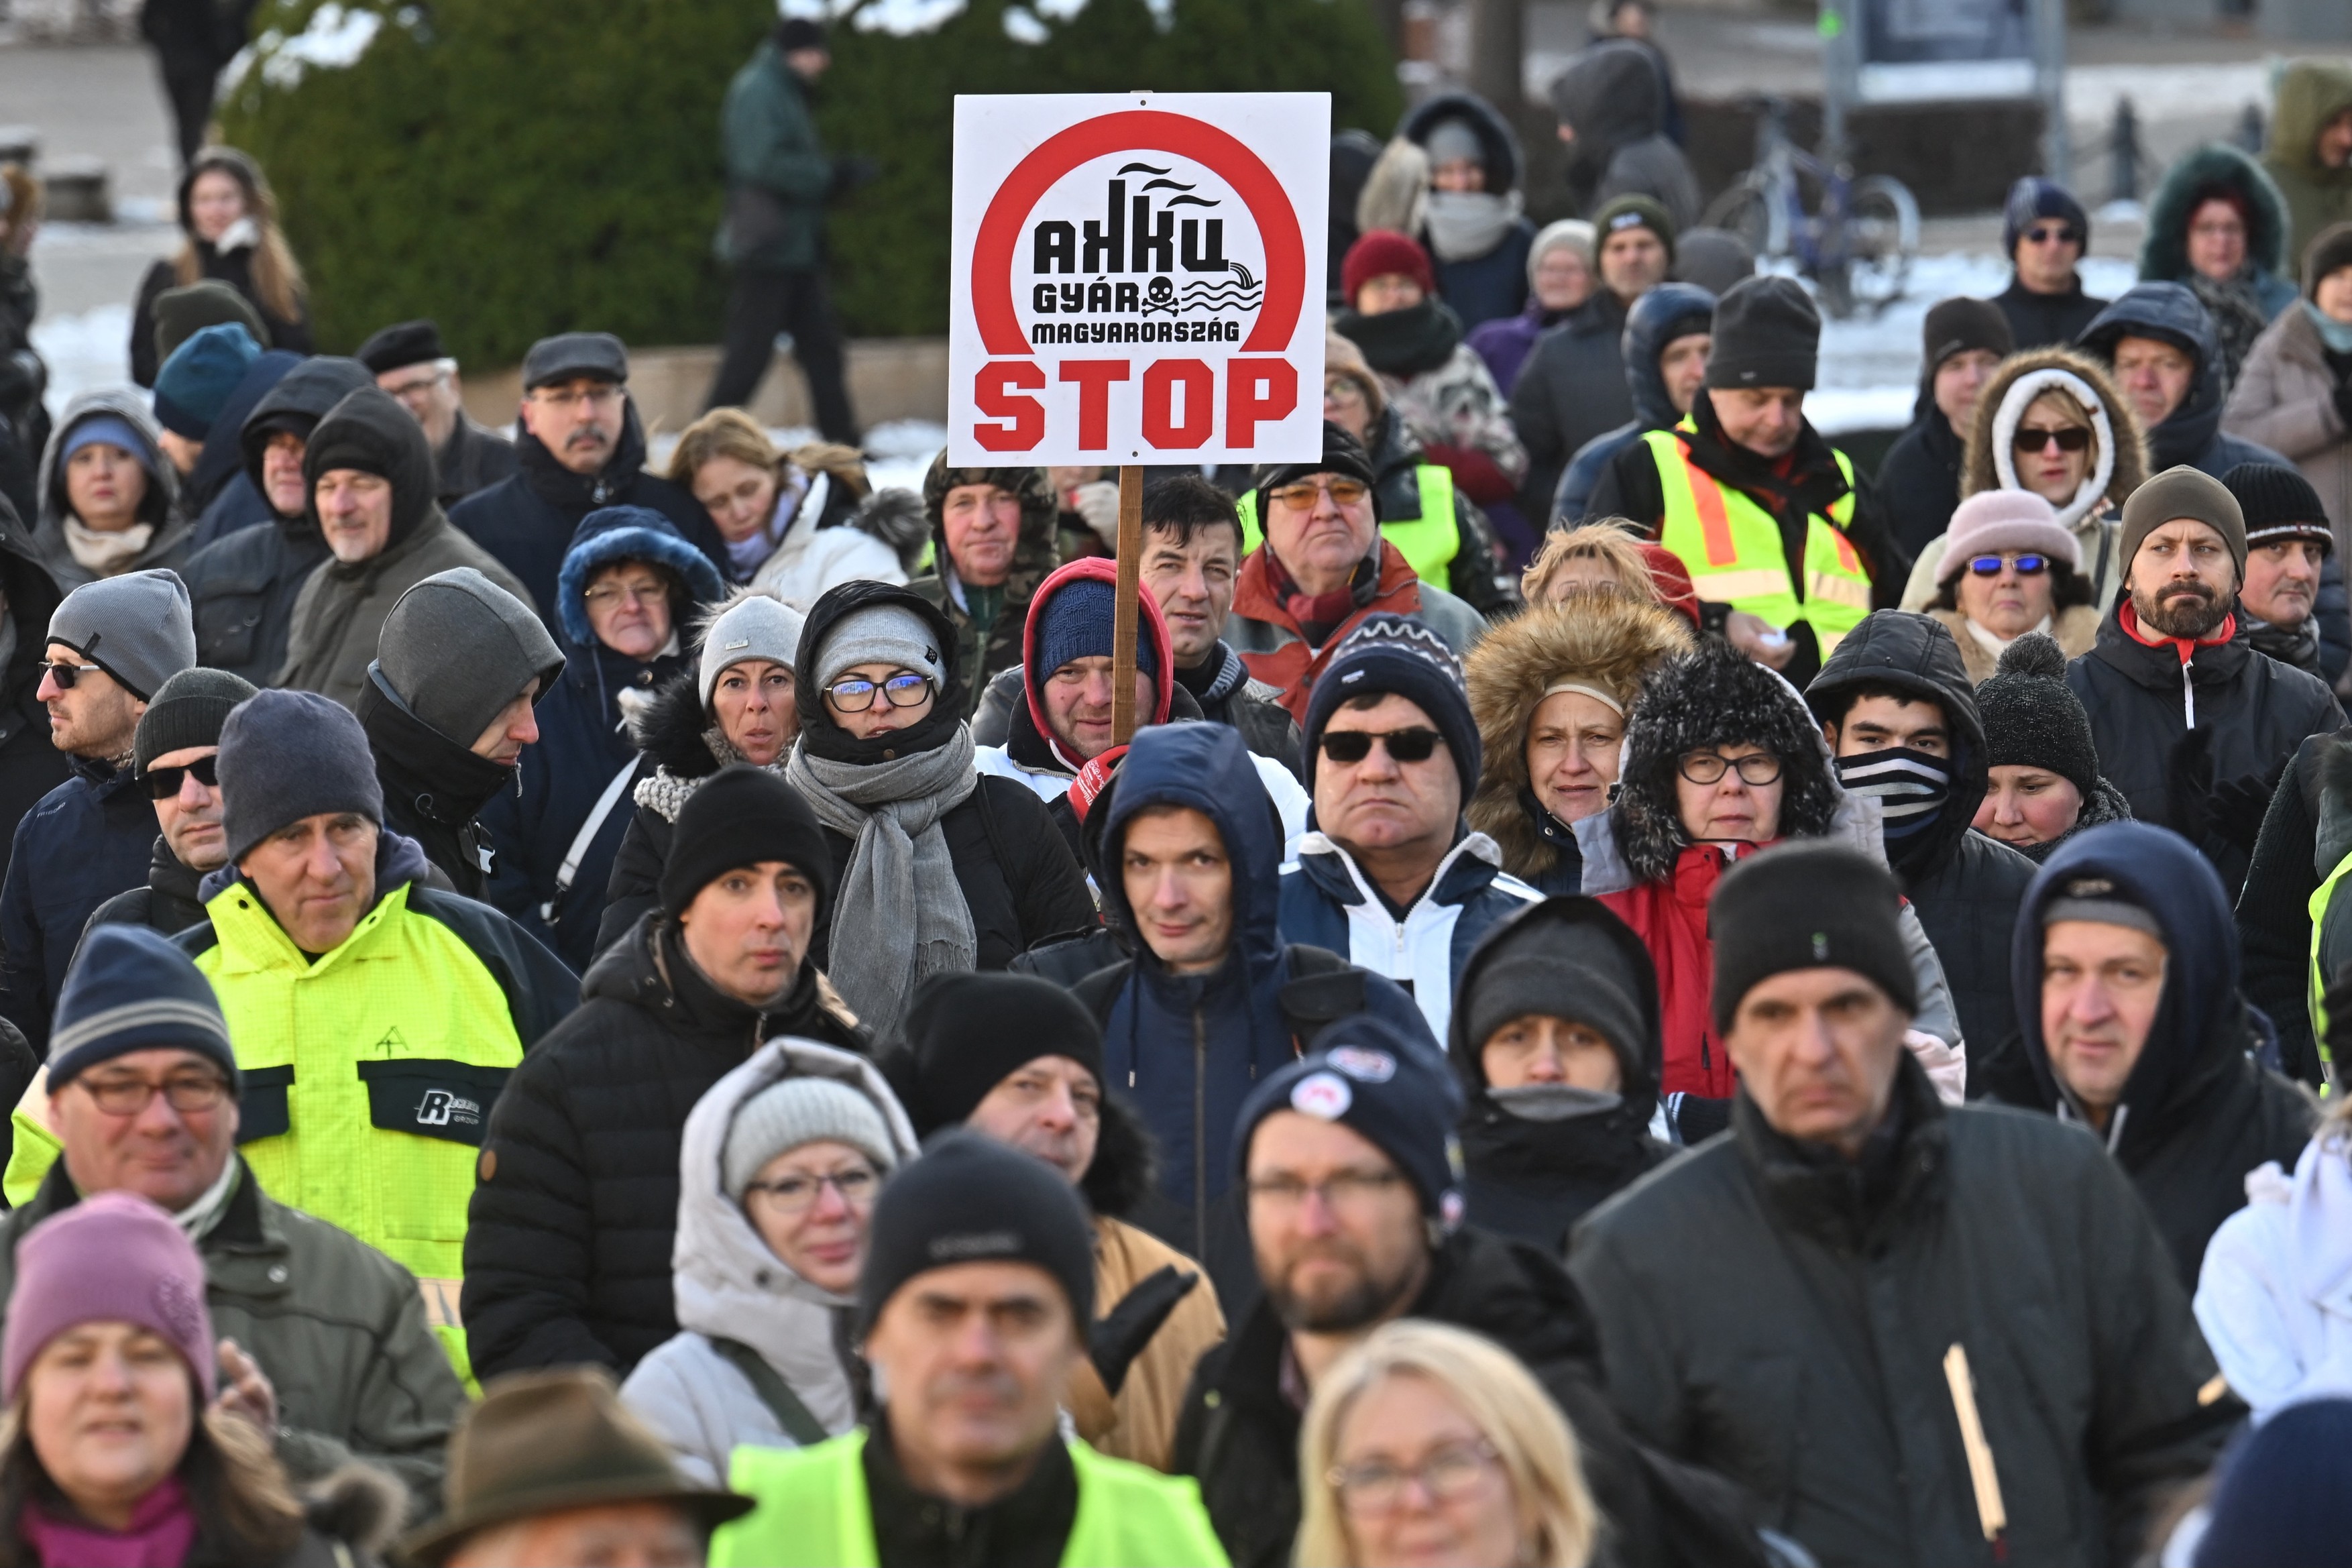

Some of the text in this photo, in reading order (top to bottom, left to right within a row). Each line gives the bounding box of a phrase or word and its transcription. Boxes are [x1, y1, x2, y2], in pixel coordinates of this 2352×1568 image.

[1033, 180, 1229, 274] AKKU
[1032, 276, 1139, 314] GYÁR
[1031, 317, 1239, 344] MAGYARORSZÁG
[974, 358, 1298, 452] STOP
[453, 1115, 479, 1125] GROUP
